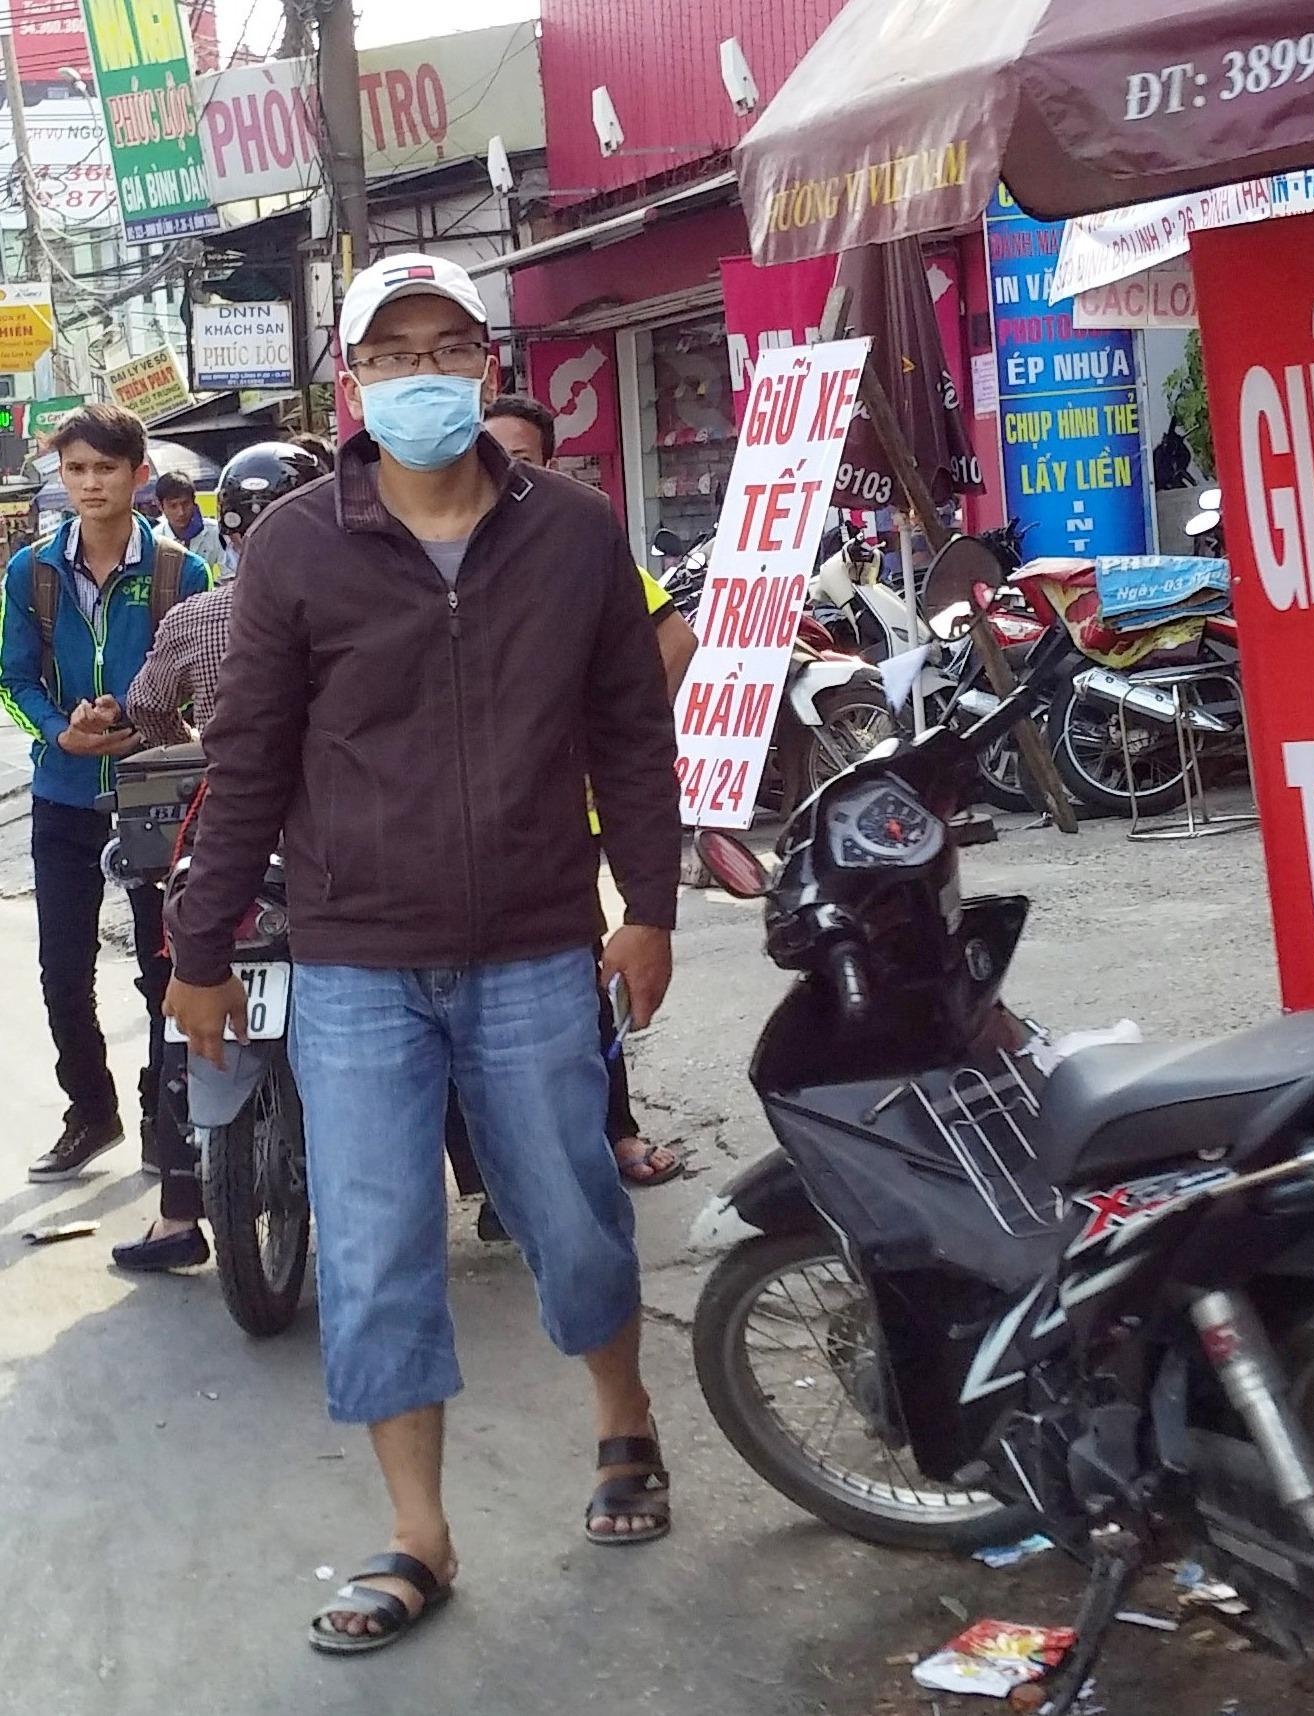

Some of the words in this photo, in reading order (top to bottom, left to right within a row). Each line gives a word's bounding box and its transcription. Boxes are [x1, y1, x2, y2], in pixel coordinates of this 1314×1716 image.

[107, 75, 160, 148] PHÚC
[206, 70, 322, 178] PHÒN
[359, 63, 448, 159] TRỌ
[121, 166, 147, 213] GIÁ
[146, 163, 180, 209] BÌNH
[179, 156, 210, 204] DÂN
[219, 305, 271, 318] DNTN
[996, 276, 1019, 305] IN
[1026, 266, 1055, 303] VĂ
[1154, 281, 1199, 317] LO
[204, 321, 252, 336] KHÁCH
[1007, 351, 1045, 386] ÉP
[1053, 346, 1130, 385] NHỰA
[807, 367, 860, 443] XE
[1005, 411, 1052, 450] CHỤP
[1058, 400, 1099, 440] HÌNH
[1103, 392, 1139, 435] THẺ
[1020, 452, 1067, 495] LẤY
[1076, 445, 1132, 491] LIỀN
[736, 459, 822, 552] TẾT
[701, 574, 806, 649] TRONG
[681, 662, 775, 738] HẦM
